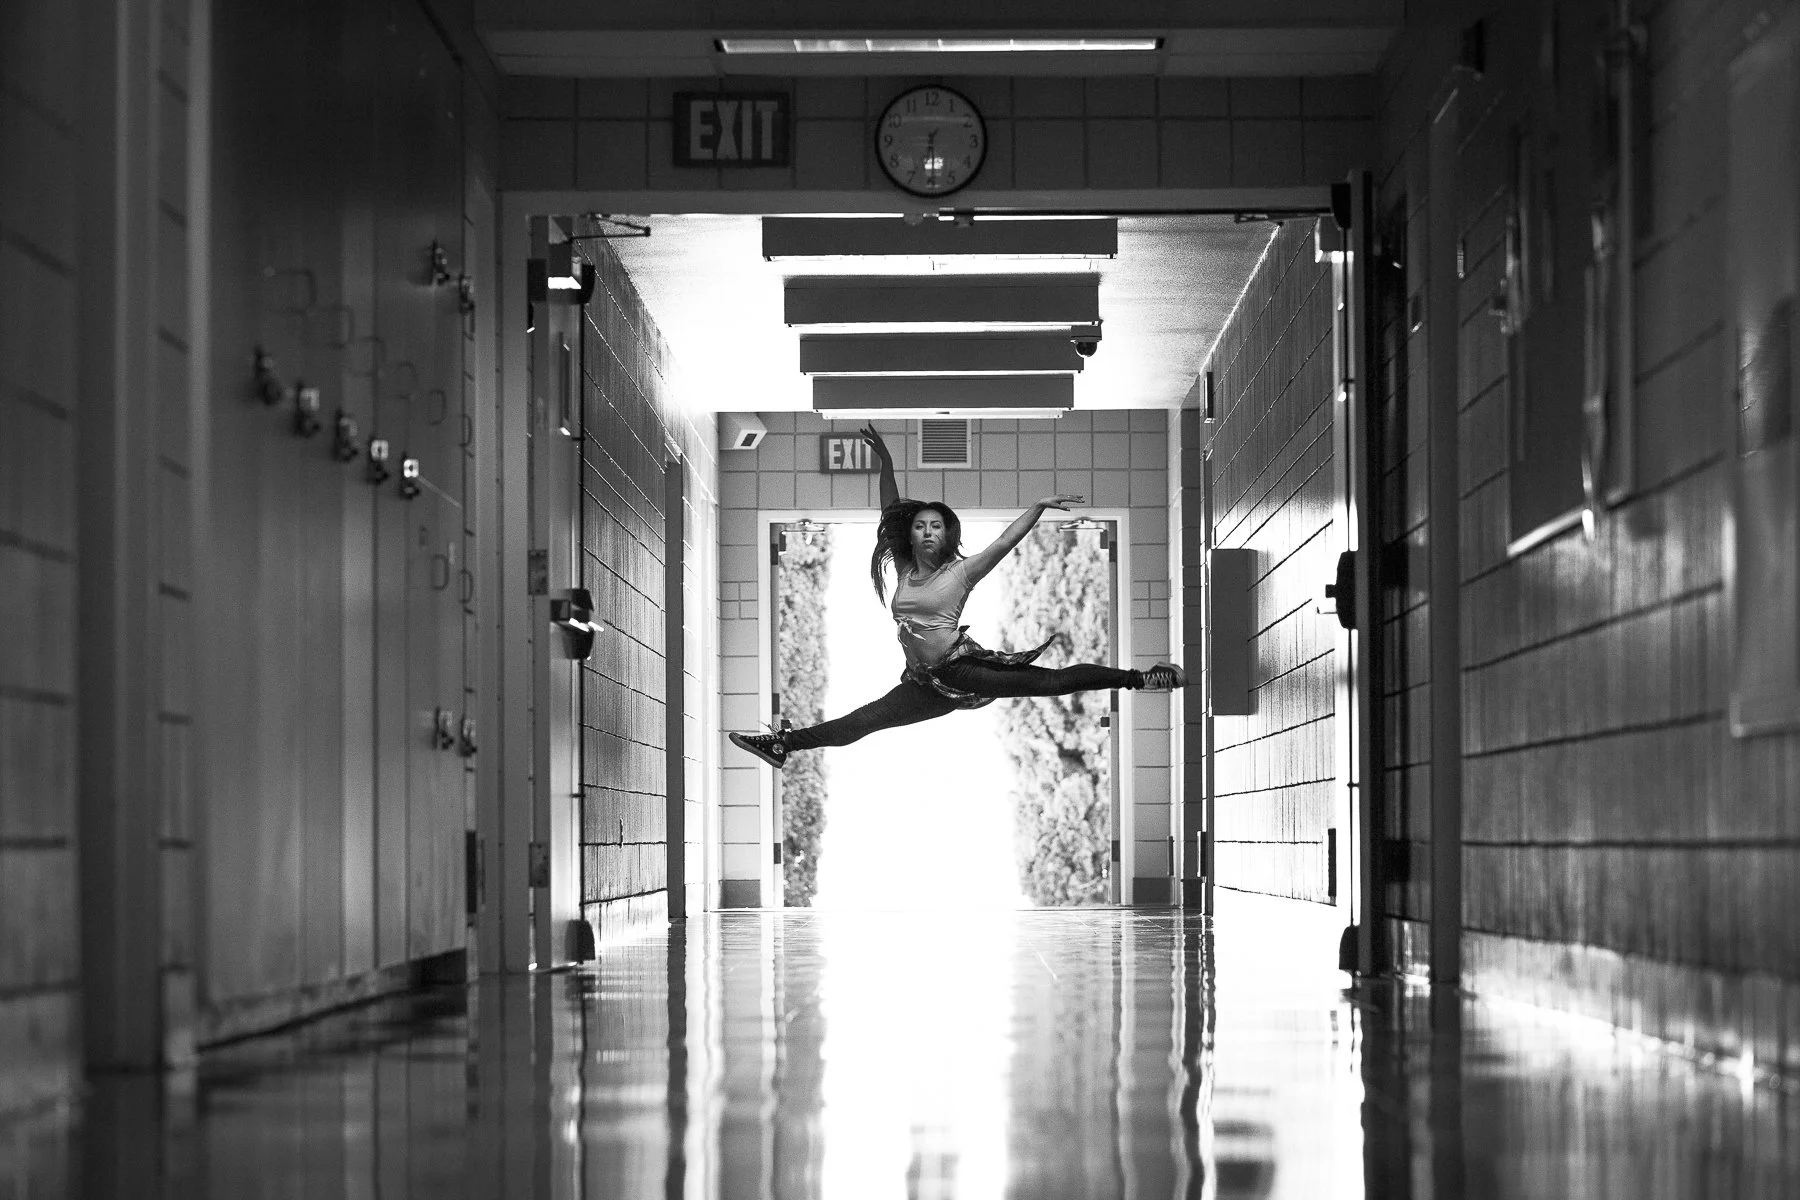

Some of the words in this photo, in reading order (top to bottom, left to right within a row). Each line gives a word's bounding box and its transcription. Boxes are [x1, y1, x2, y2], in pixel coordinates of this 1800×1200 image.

[907, 99, 917, 113] 11
[925, 91, 940, 106] 12
[888, 113, 901, 129] 10
[962, 113, 973, 129] 2
[690, 100, 778, 160] EXIT
[884, 135, 893, 148] 9
[969, 134, 979, 149] 3
[889, 153, 899, 169] 8
[962, 154, 971, 169] 4
[907, 170, 916, 185] 7
[947, 170, 956, 185] 5
[828, 438, 873, 470] EXIT
